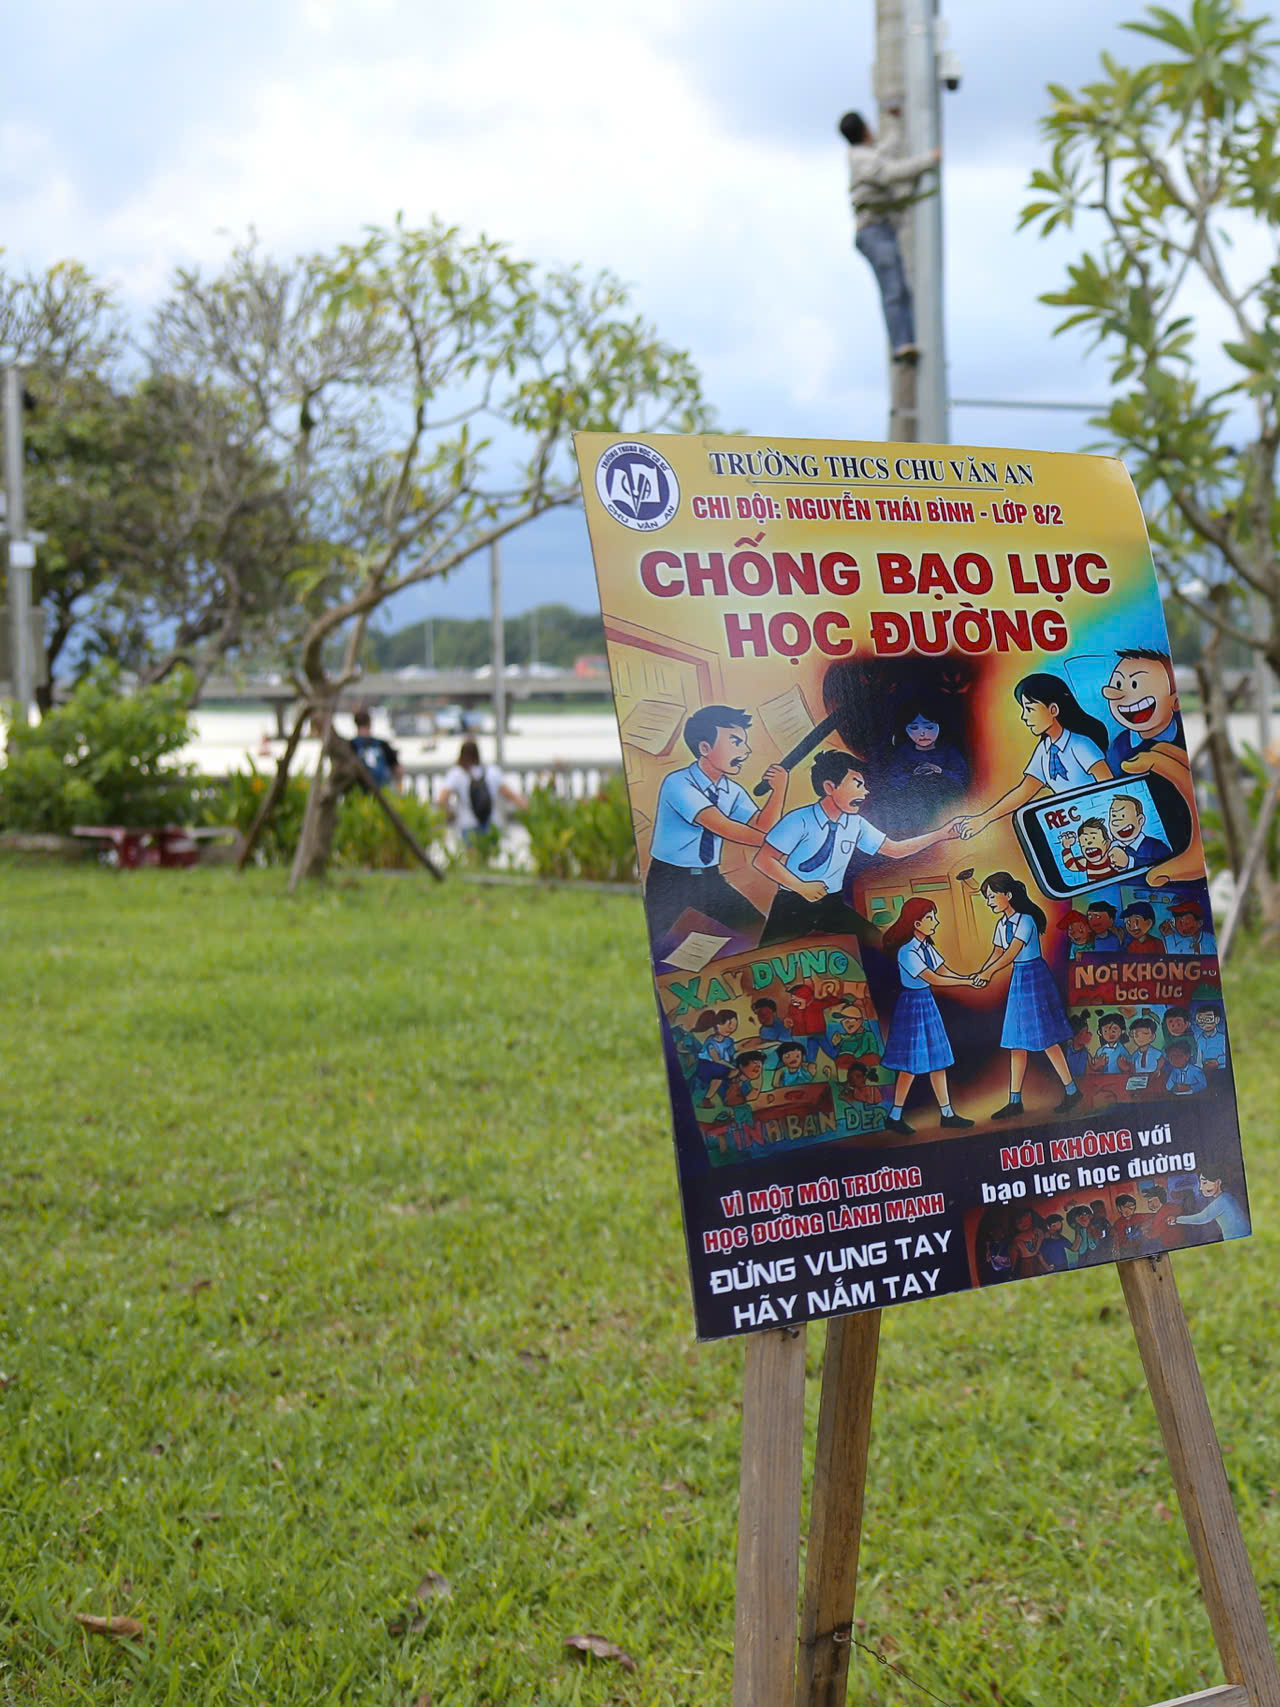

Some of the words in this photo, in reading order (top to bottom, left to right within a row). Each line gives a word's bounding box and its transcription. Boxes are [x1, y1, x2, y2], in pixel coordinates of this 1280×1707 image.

[709, 447, 819, 477] TRƯỜNG
[824, 456, 889, 479] THCS
[895, 458, 945, 481] CHU
[950, 456, 998, 483] VĂN
[1005, 464, 1033, 485] AN
[608, 503, 629, 523] CHU
[663, 505, 675, 520] AN
[692, 496, 731, 519] CHI
[737, 492, 782, 524] ĐỘI:
[786, 490, 871, 521] NGUYỄN
[875, 496, 922, 522] THÁI
[926, 497, 975, 523] BÌNH
[992, 499, 1027, 524] LỚP
[1032, 504, 1063, 525] 8/2
[640, 531, 861, 597] CHỐNG
[876, 550, 994, 601] BẠO
[1007, 552, 1111, 602] LỰC
[723, 610, 853, 665] HỌC
[870, 601, 1068, 656] ĐƯỜNG
[1044, 806, 1081, 830] REC
[1000, 1140, 1045, 1171] NÓI
[1050, 1130, 1133, 1162] KHÔNG
[1137, 1124, 1172, 1148] với
[721, 1190, 744, 1218] VÌ
[748, 1185, 793, 1214] MỘT
[798, 1177, 839, 1206] MÔI
[843, 1166, 921, 1197] TRƯỜNG
[981, 1180, 1026, 1205] bạo
[1034, 1172, 1071, 1197] lực
[1078, 1164, 1121, 1189] học
[1128, 1152, 1196, 1179] đường
[703, 1227, 748, 1255] HỌC
[752, 1213, 824, 1246] ĐƯỜNG
[828, 1204, 882, 1232] LÀNH
[885, 1193, 944, 1224] MẠNH
[710, 1257, 796, 1295] ĐỪNG
[804, 1241, 887, 1276] VUNG
[895, 1230, 952, 1260] TAY
[733, 1293, 798, 1329] HÃY
[807, 1277, 876, 1315] NẮM
[882, 1268, 941, 1299] TAY
